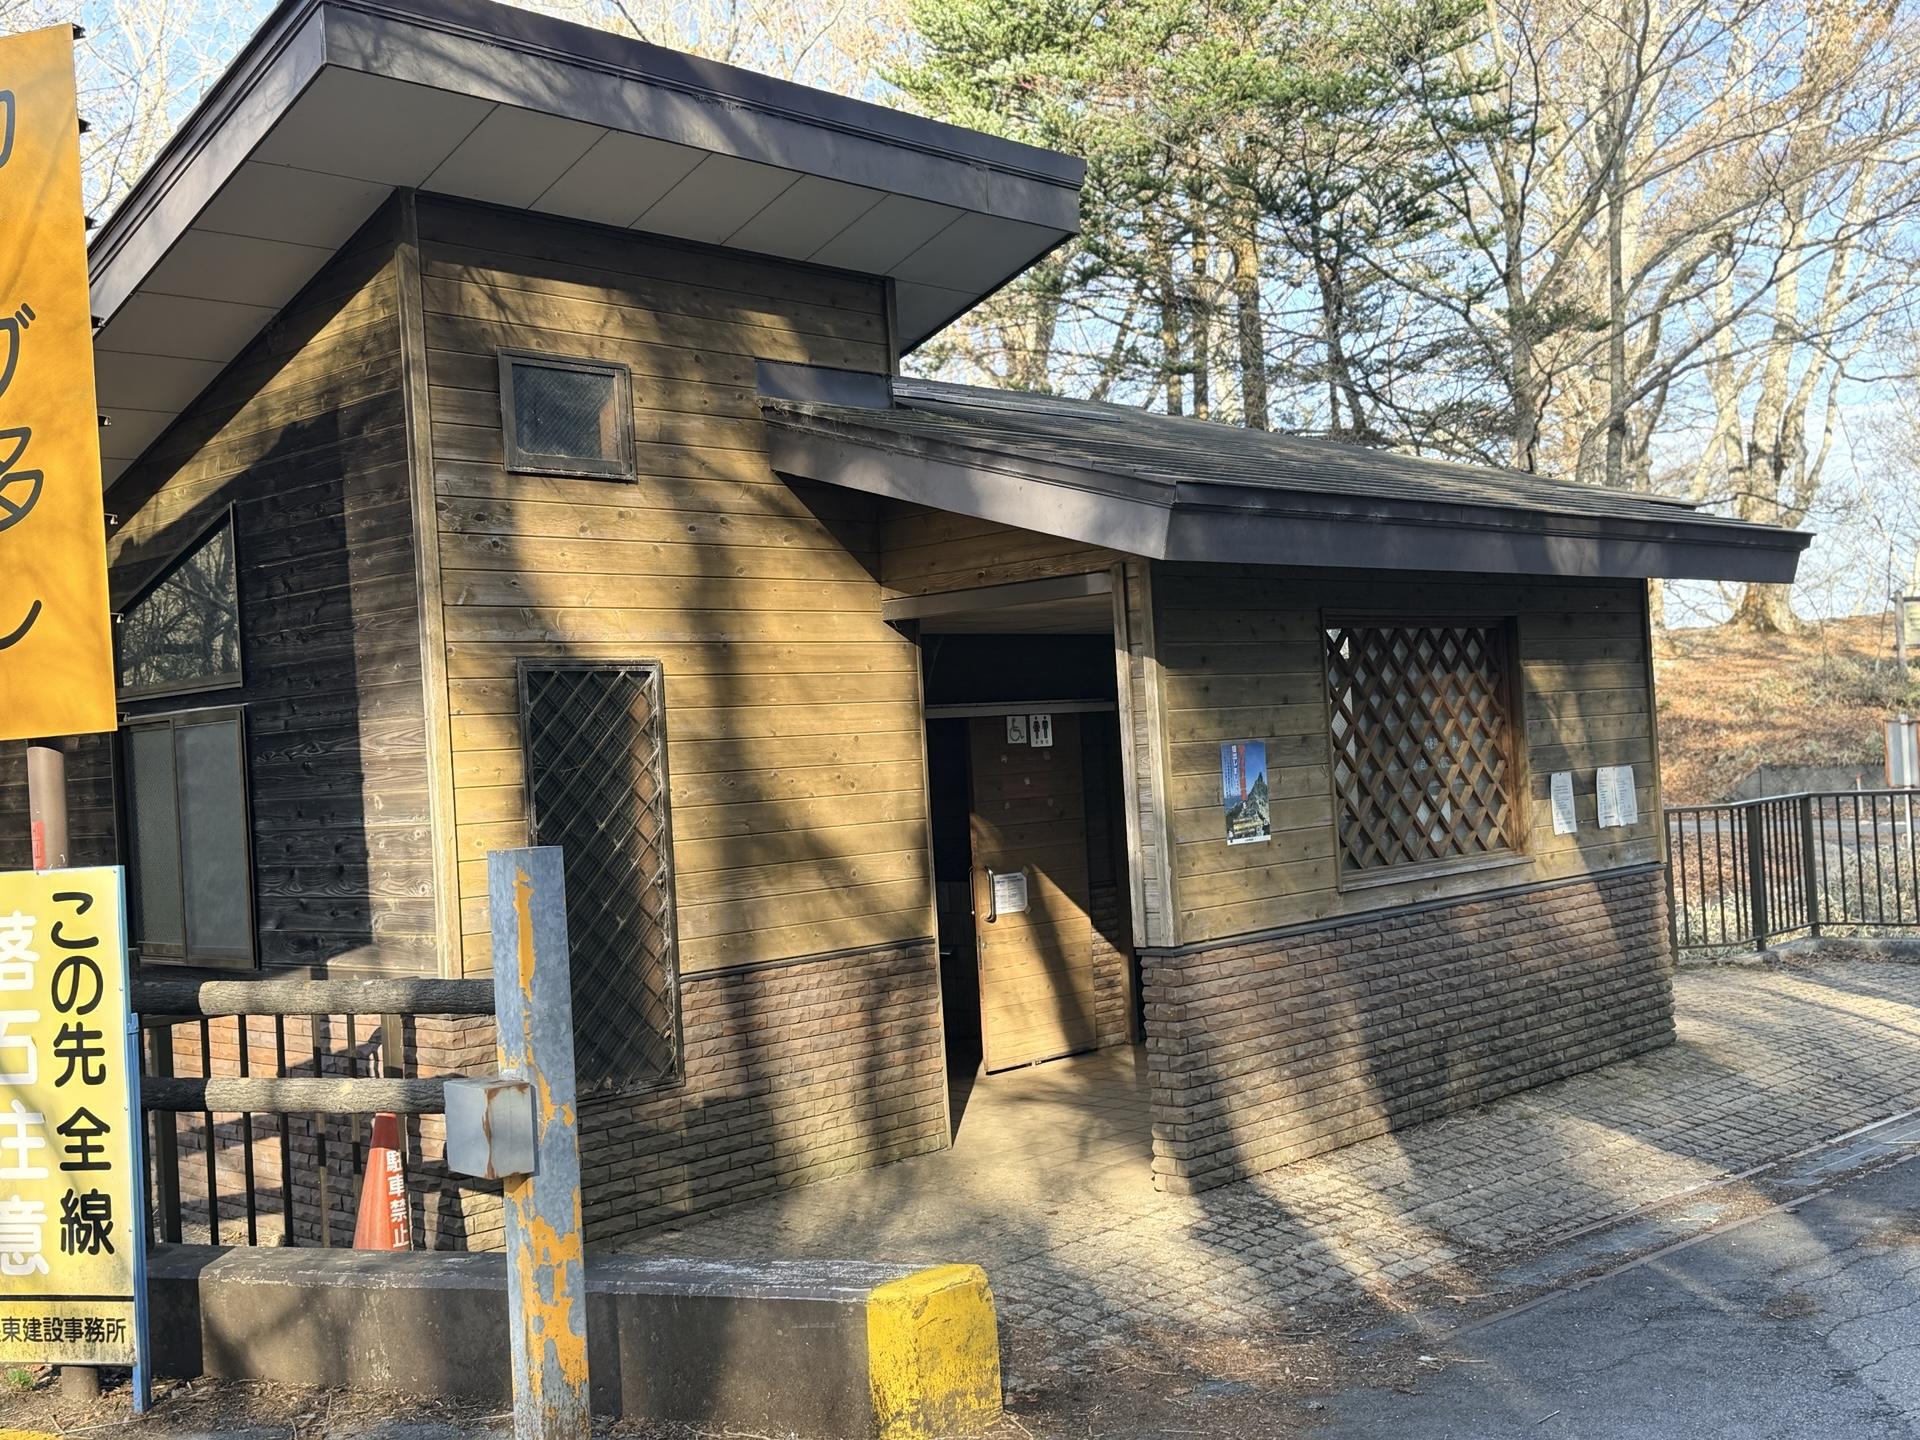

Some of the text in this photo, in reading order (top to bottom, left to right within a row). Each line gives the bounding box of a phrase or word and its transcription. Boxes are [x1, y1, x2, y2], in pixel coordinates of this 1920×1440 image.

[51, 891, 115, 1255] この先全線
[386, 1150, 409, 1248] 駐車禁止
[0, 1316, 126, 1344] 東建設事務所
